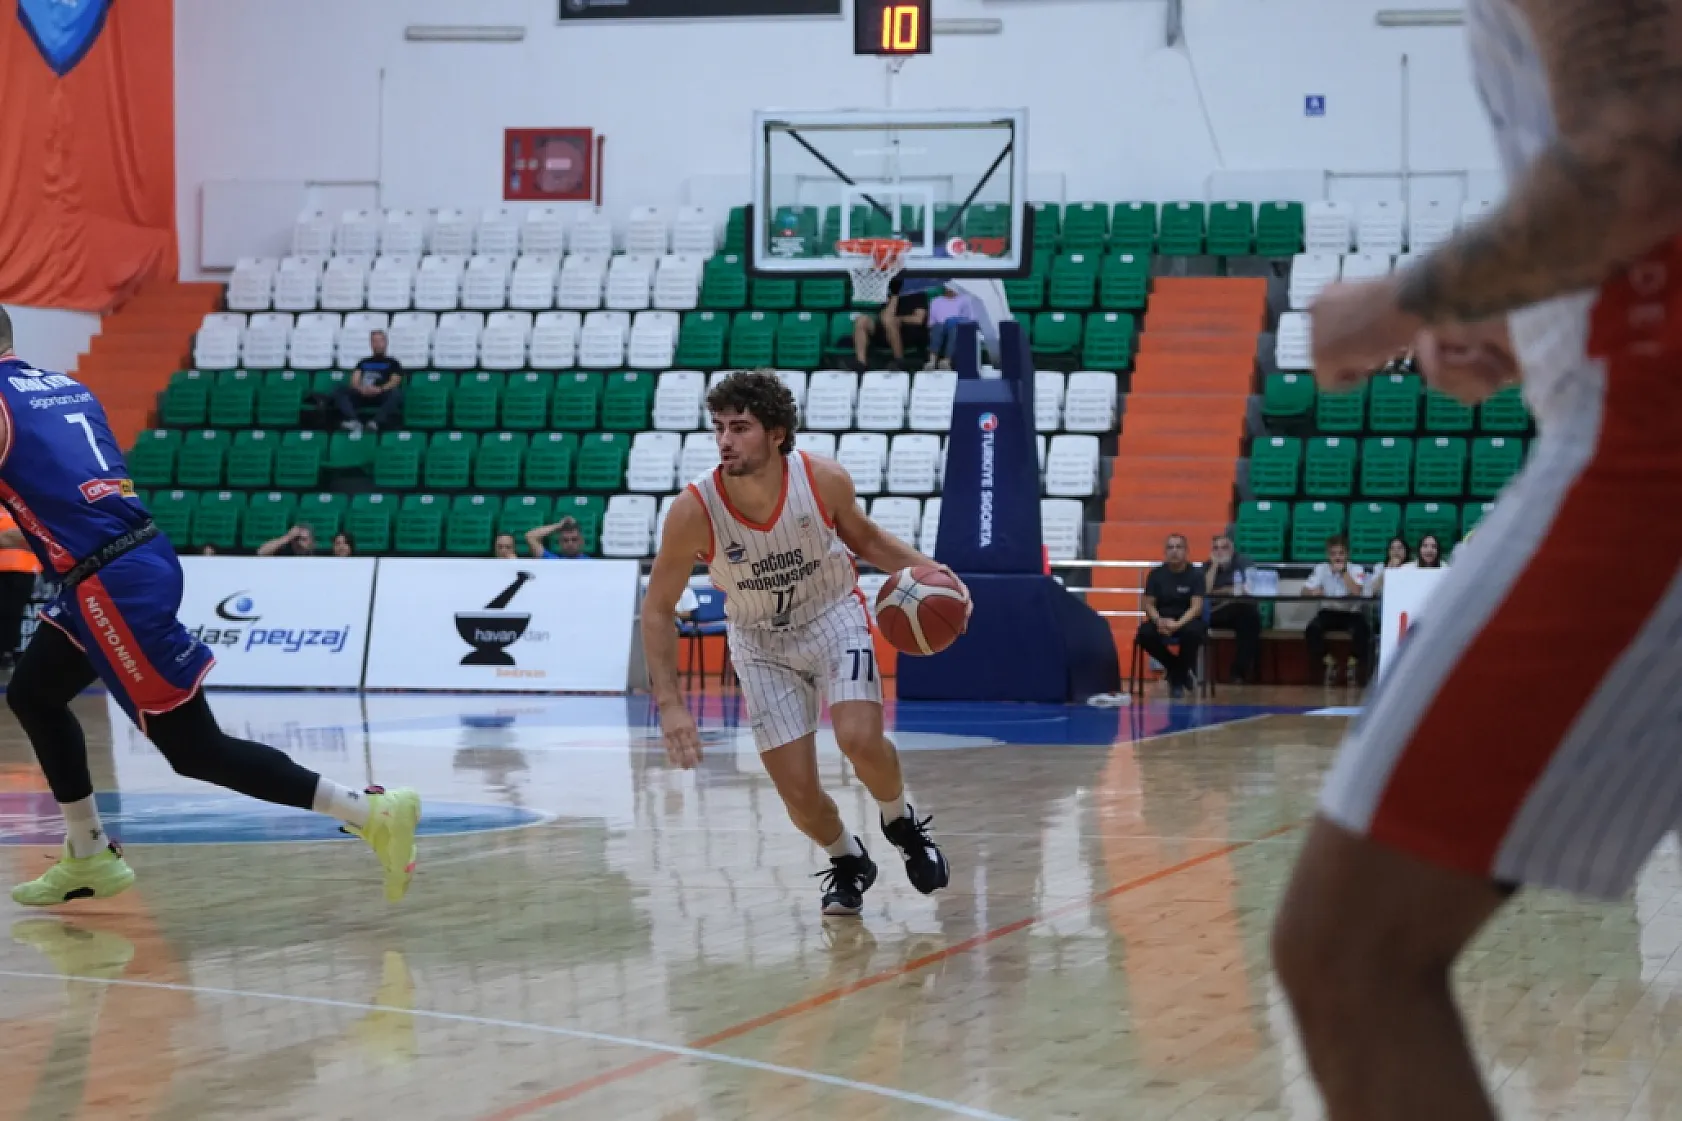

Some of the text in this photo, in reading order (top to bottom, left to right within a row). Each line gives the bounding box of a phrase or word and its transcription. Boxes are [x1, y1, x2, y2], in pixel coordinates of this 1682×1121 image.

[882, 6, 919, 50] 10
[63, 412, 109, 471] 7
[771, 585, 796, 614] 77
[244, 624, 350, 653] peyzaj
[846, 648, 874, 682] 77
